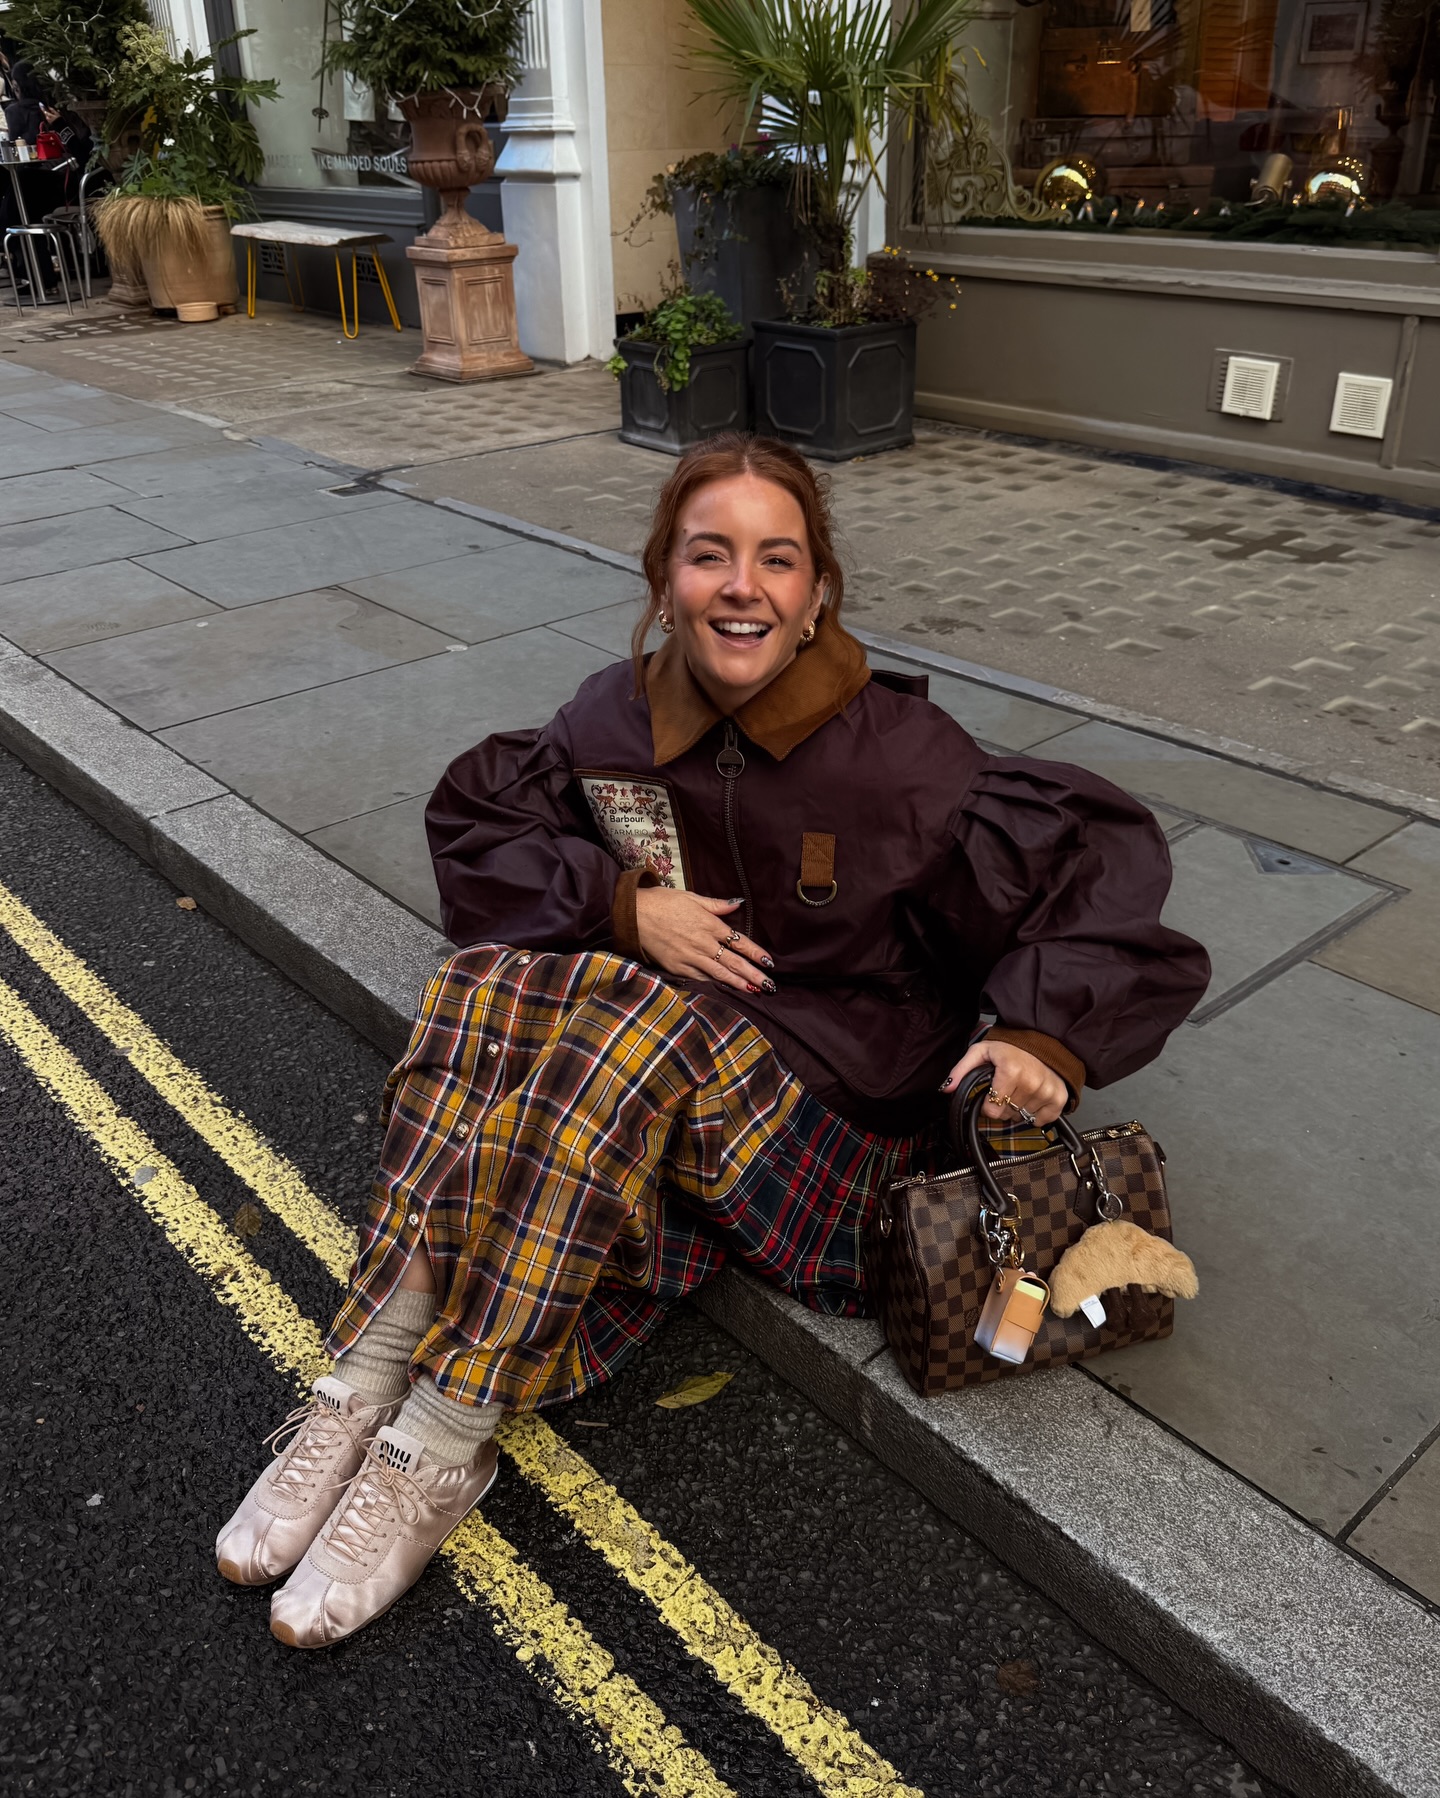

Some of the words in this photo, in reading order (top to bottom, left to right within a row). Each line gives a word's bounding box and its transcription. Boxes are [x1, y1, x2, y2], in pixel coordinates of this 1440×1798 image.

[333, 155, 371, 171] MINDED
[373, 156, 407, 173] SOULS
[610, 828, 632, 836] FARM
